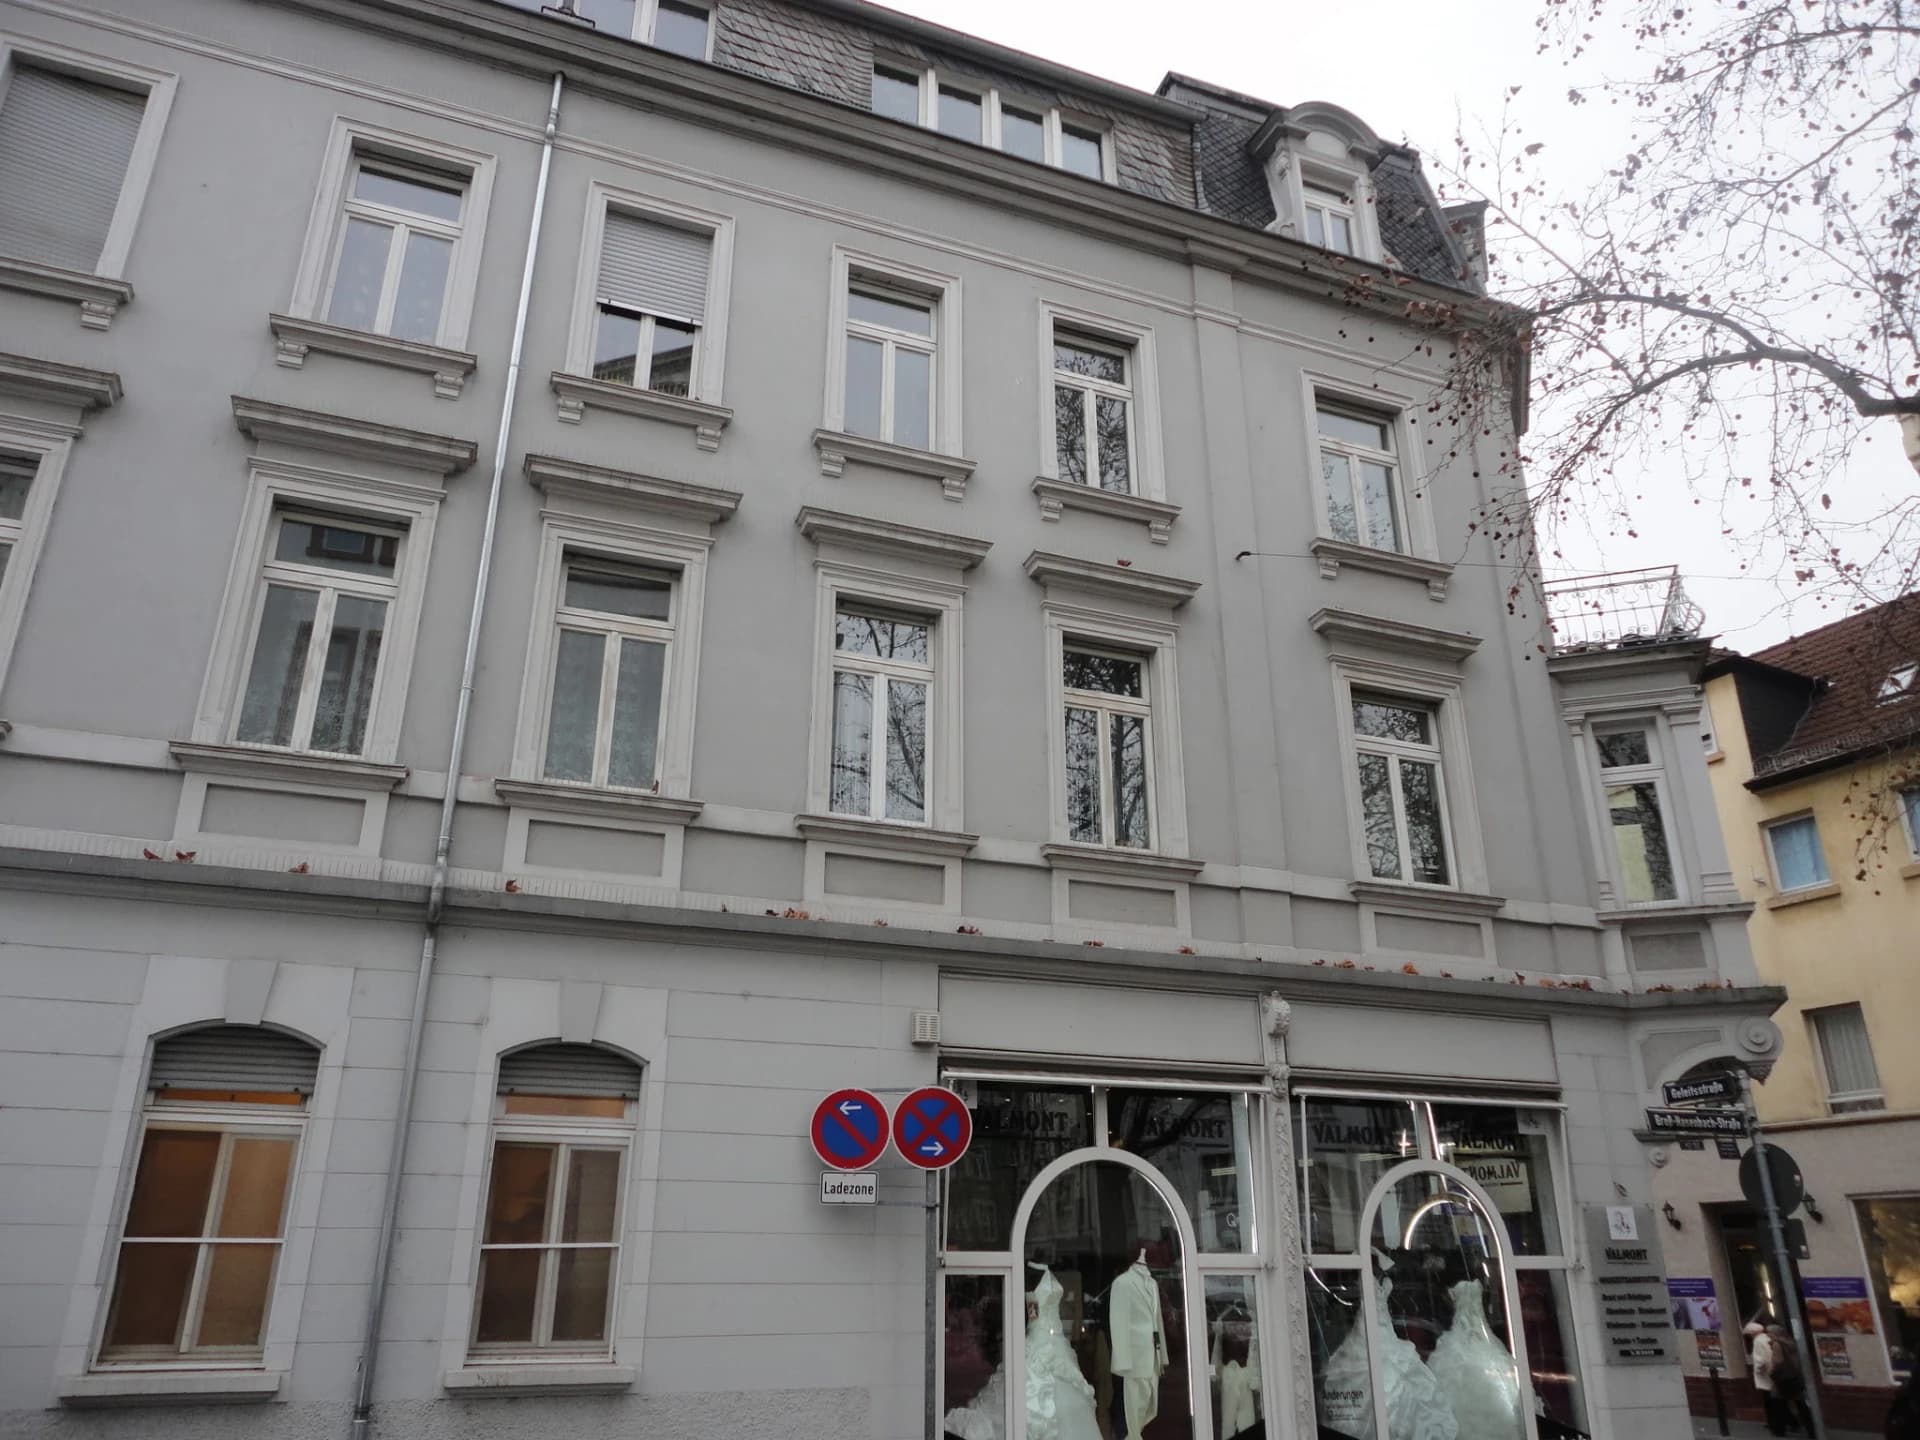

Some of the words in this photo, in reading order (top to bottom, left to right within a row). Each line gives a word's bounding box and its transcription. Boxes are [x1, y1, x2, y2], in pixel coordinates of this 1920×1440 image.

[1671, 1081, 1724, 1099] Geleitsstraße
[824, 1181, 874, 1195] Ladezone
[1605, 1247, 1648, 1260] VALMONT
